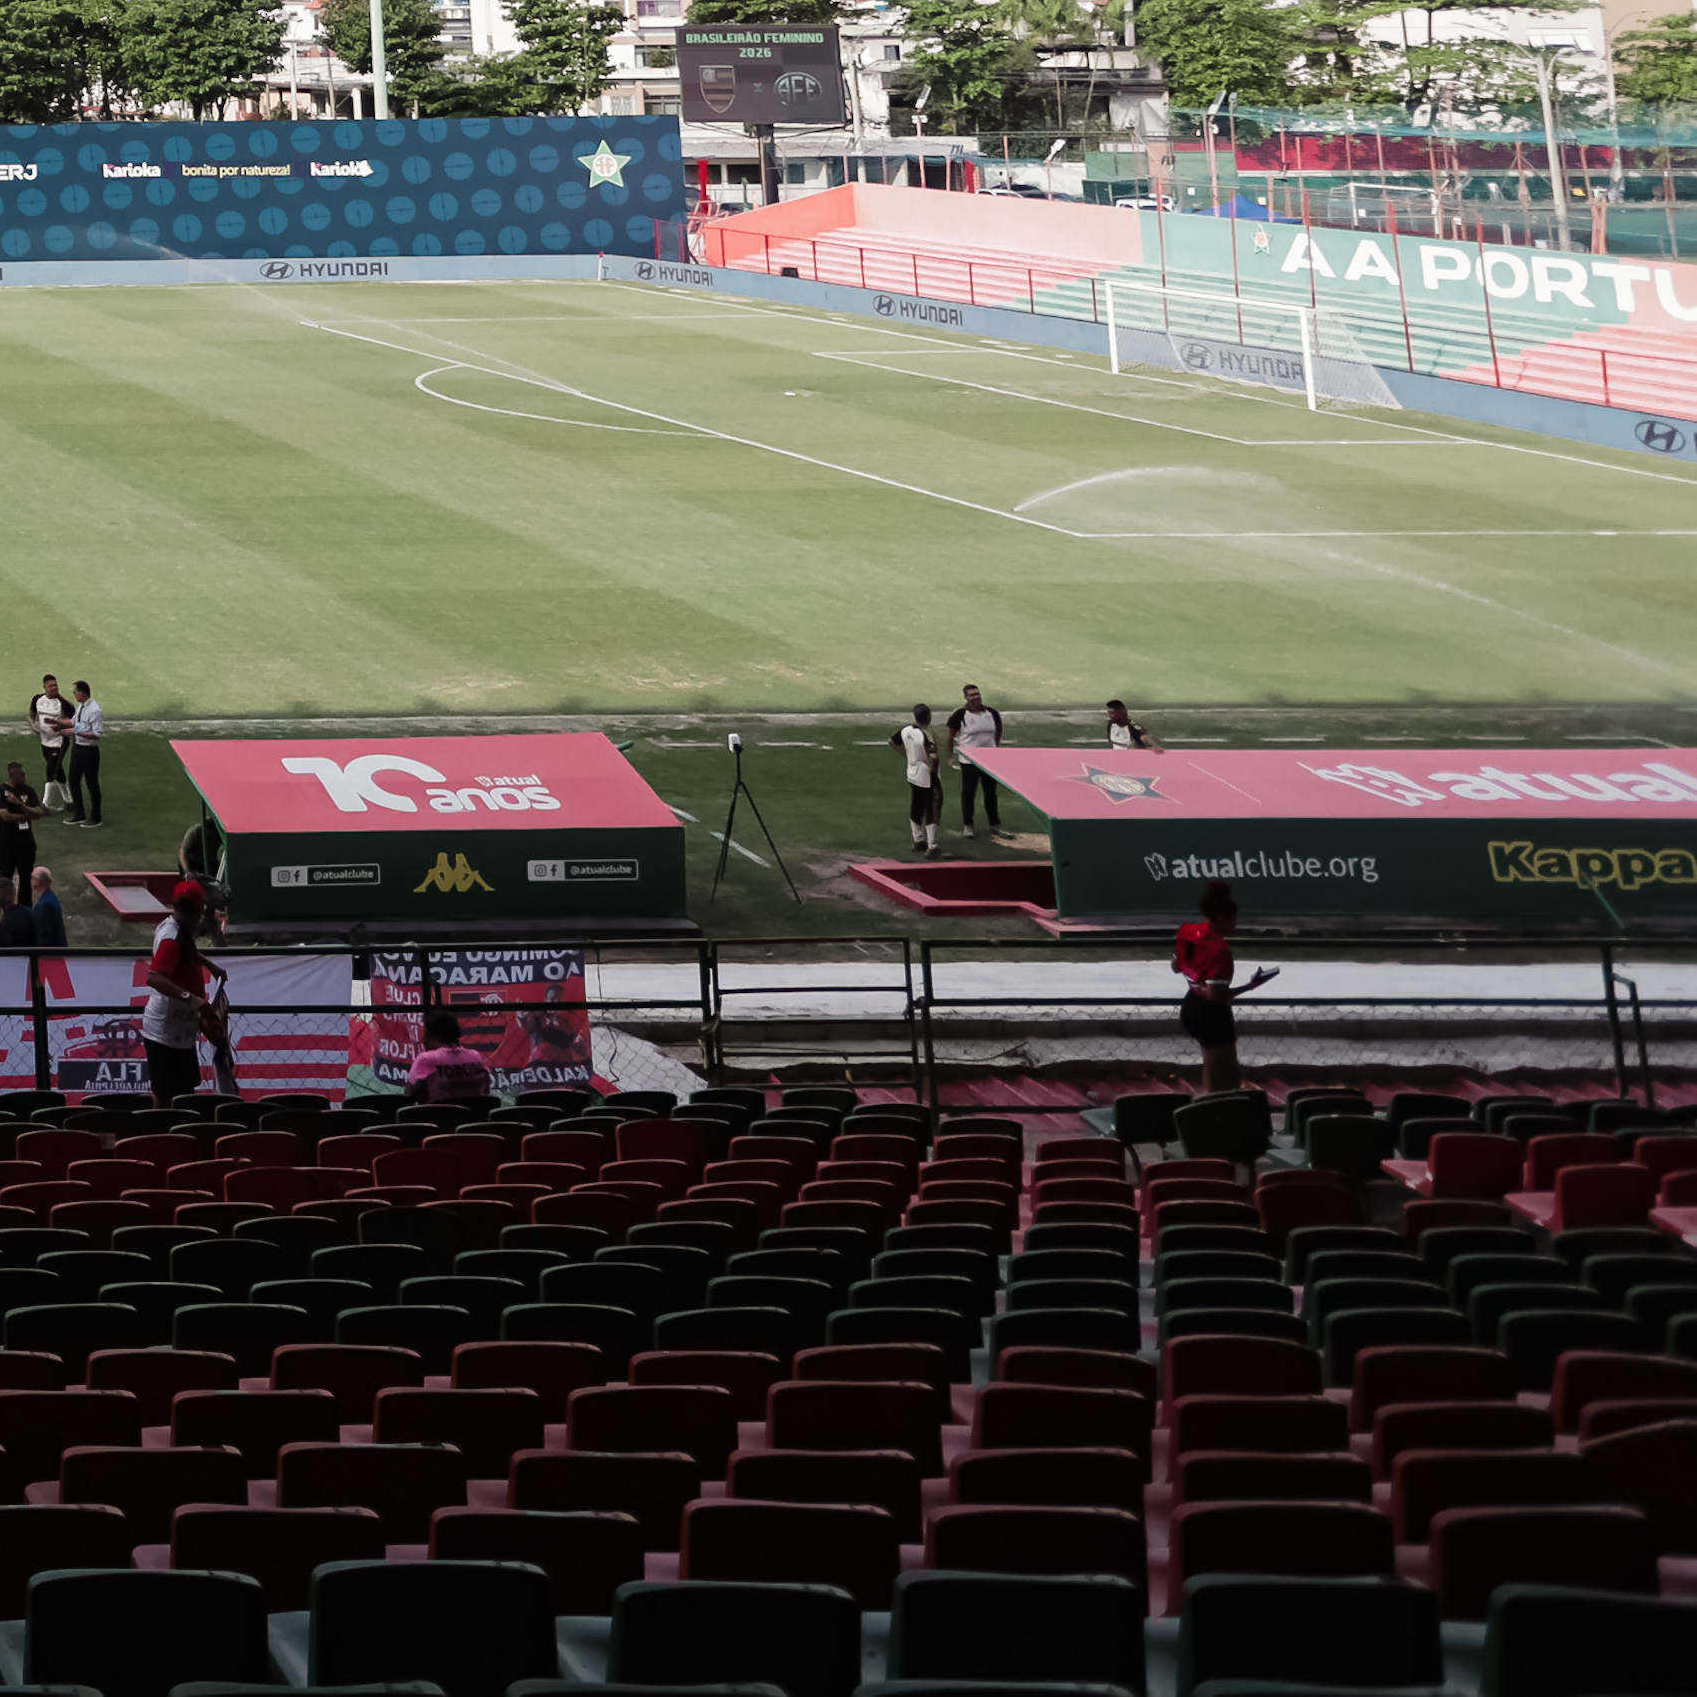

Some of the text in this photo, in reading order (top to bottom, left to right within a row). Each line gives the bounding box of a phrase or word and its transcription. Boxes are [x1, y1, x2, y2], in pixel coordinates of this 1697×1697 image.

[686, 32, 824, 44] BRASILEIRÃO FEMININO
[739, 48, 772, 58] 2026
[182, 164, 290, 178] bonita por natureza!
[1280, 233, 1336, 278] A
[1344, 239, 1400, 286] A
[300, 262, 388, 277] HYUNDAI
[659, 266, 714, 287] HYUNDAI
[899, 300, 964, 326] HYUNDAI
[1219, 351, 1305, 382] HYUNDA
[494, 774, 542, 787] atual
[426, 787, 562, 814] anos
[313, 869, 374, 880] @atualclube
[570, 864, 632, 875] @atualclube
[1172, 849, 1379, 884] atualclube.org
[1488, 840, 1697, 891] Kappa
